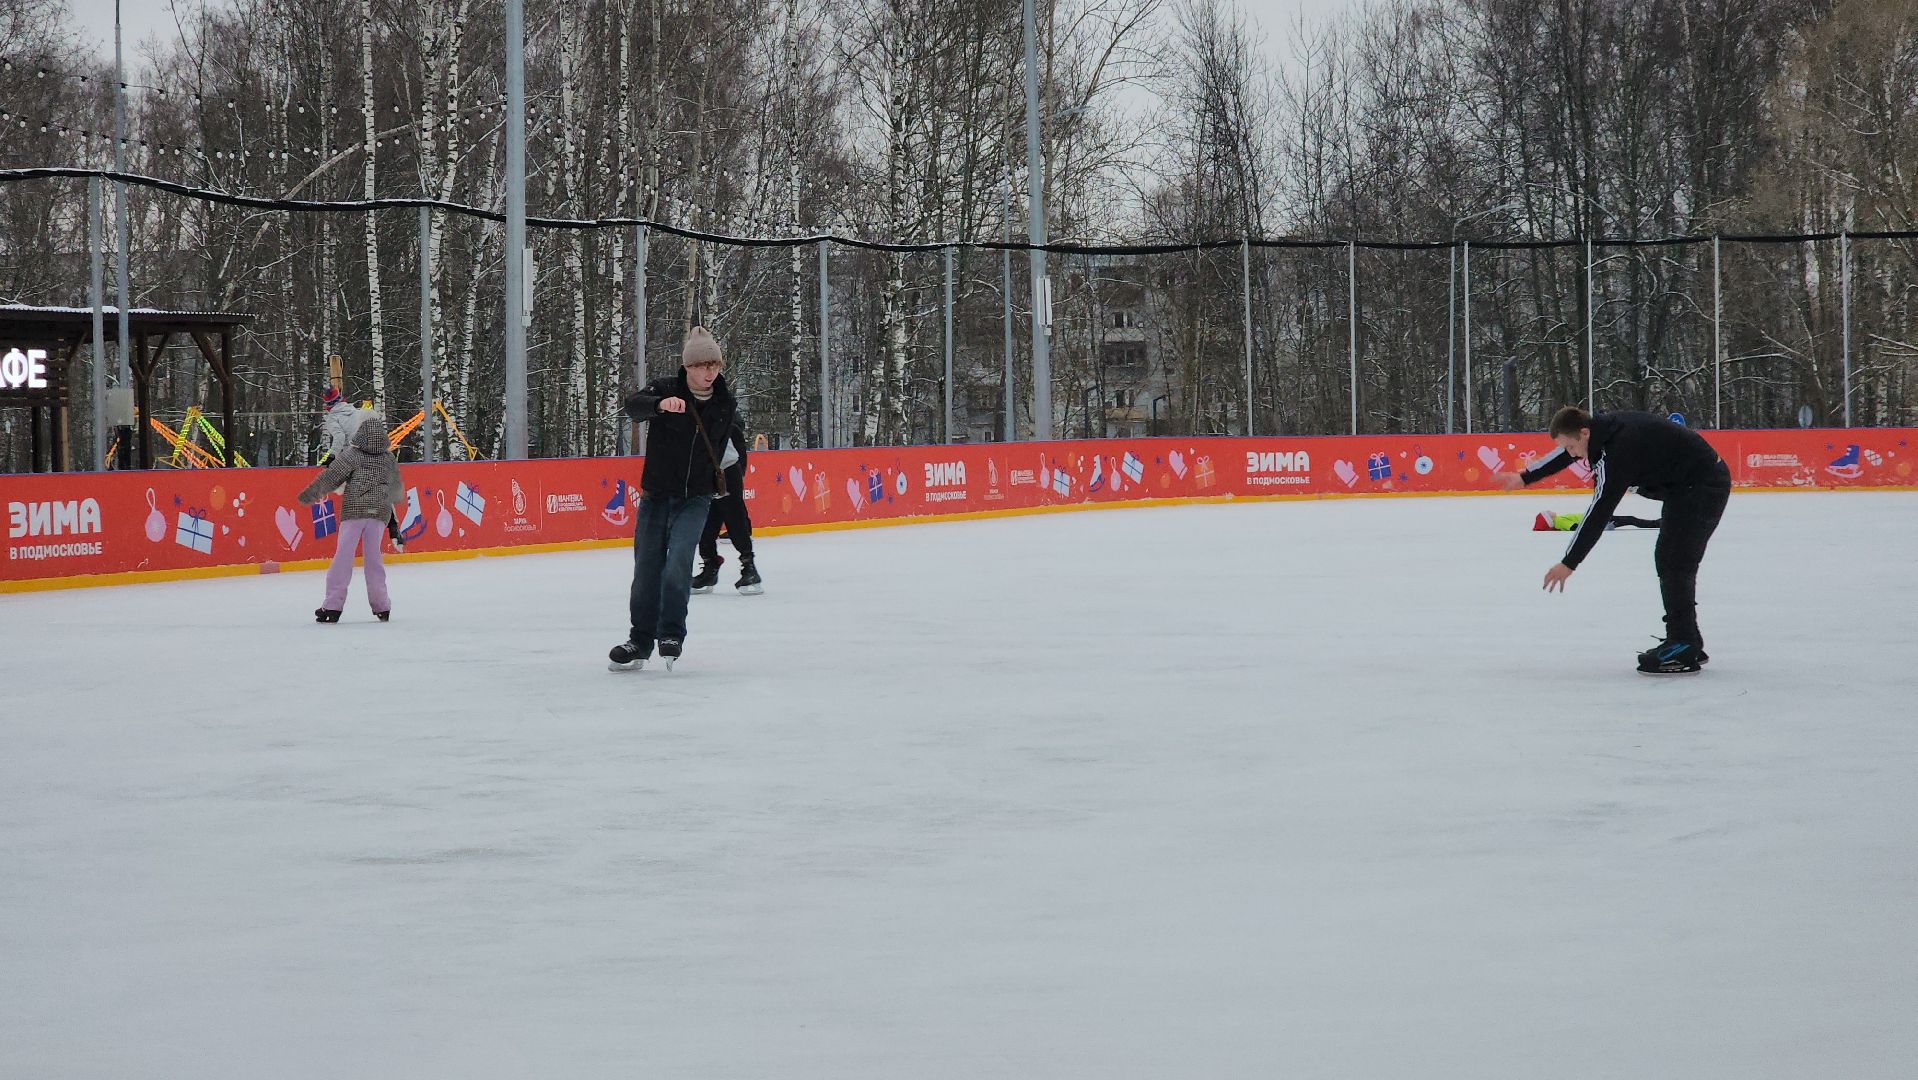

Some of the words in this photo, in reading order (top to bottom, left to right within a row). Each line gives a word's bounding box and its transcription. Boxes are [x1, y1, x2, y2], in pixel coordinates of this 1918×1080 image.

[1246, 450, 1310, 473] ЗИМА
[924, 460, 966, 488] ЗИМА
[1253, 476, 1311, 486] ПОДМОСКОВЬЕ
[8, 497, 102, 538] ЗИМА
[10, 547, 18, 560] В
[20, 541, 103, 560] ПОДМОСКОВЬЕ
